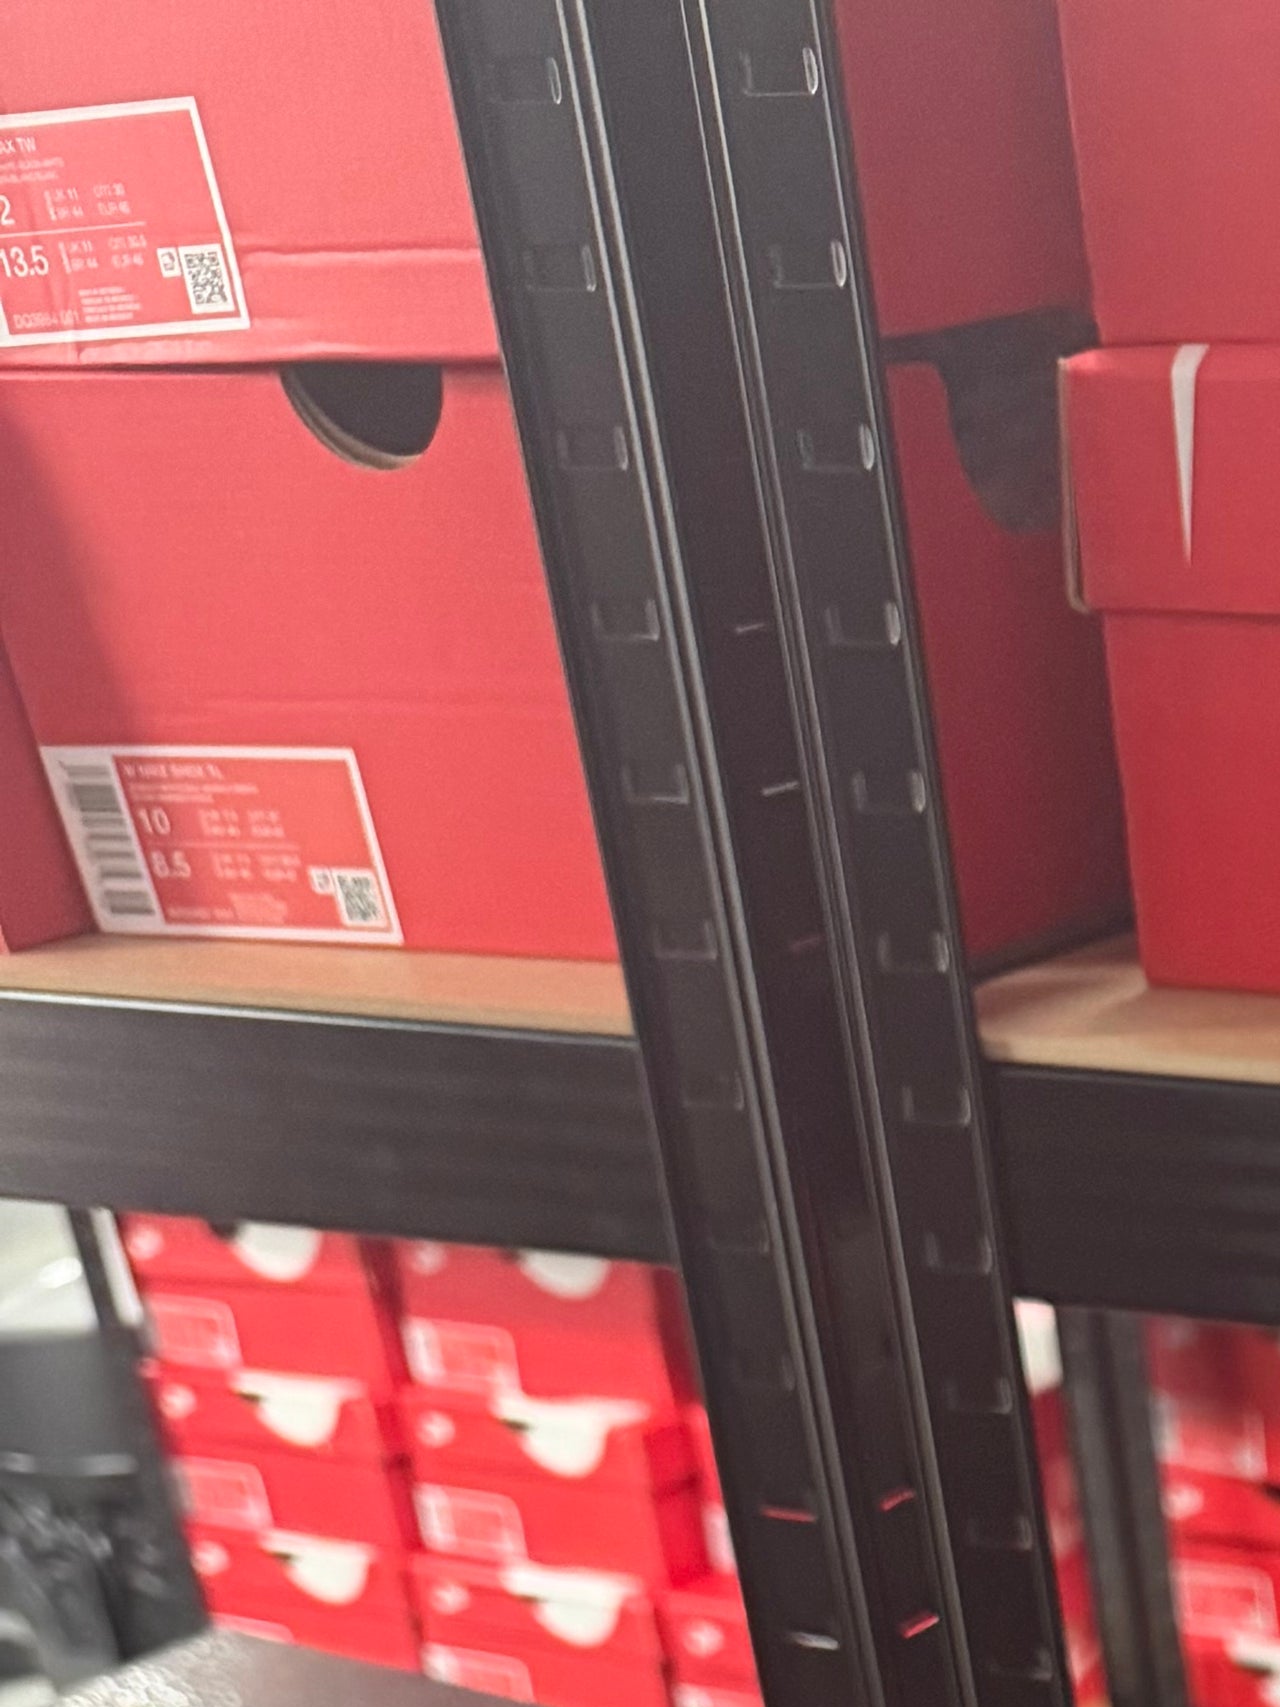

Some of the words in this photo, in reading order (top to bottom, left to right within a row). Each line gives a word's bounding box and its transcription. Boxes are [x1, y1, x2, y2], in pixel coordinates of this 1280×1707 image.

[0, 245, 49, 278] 13.5
[137, 808, 171, 835] 10
[151, 850, 192, 879] 8.5
